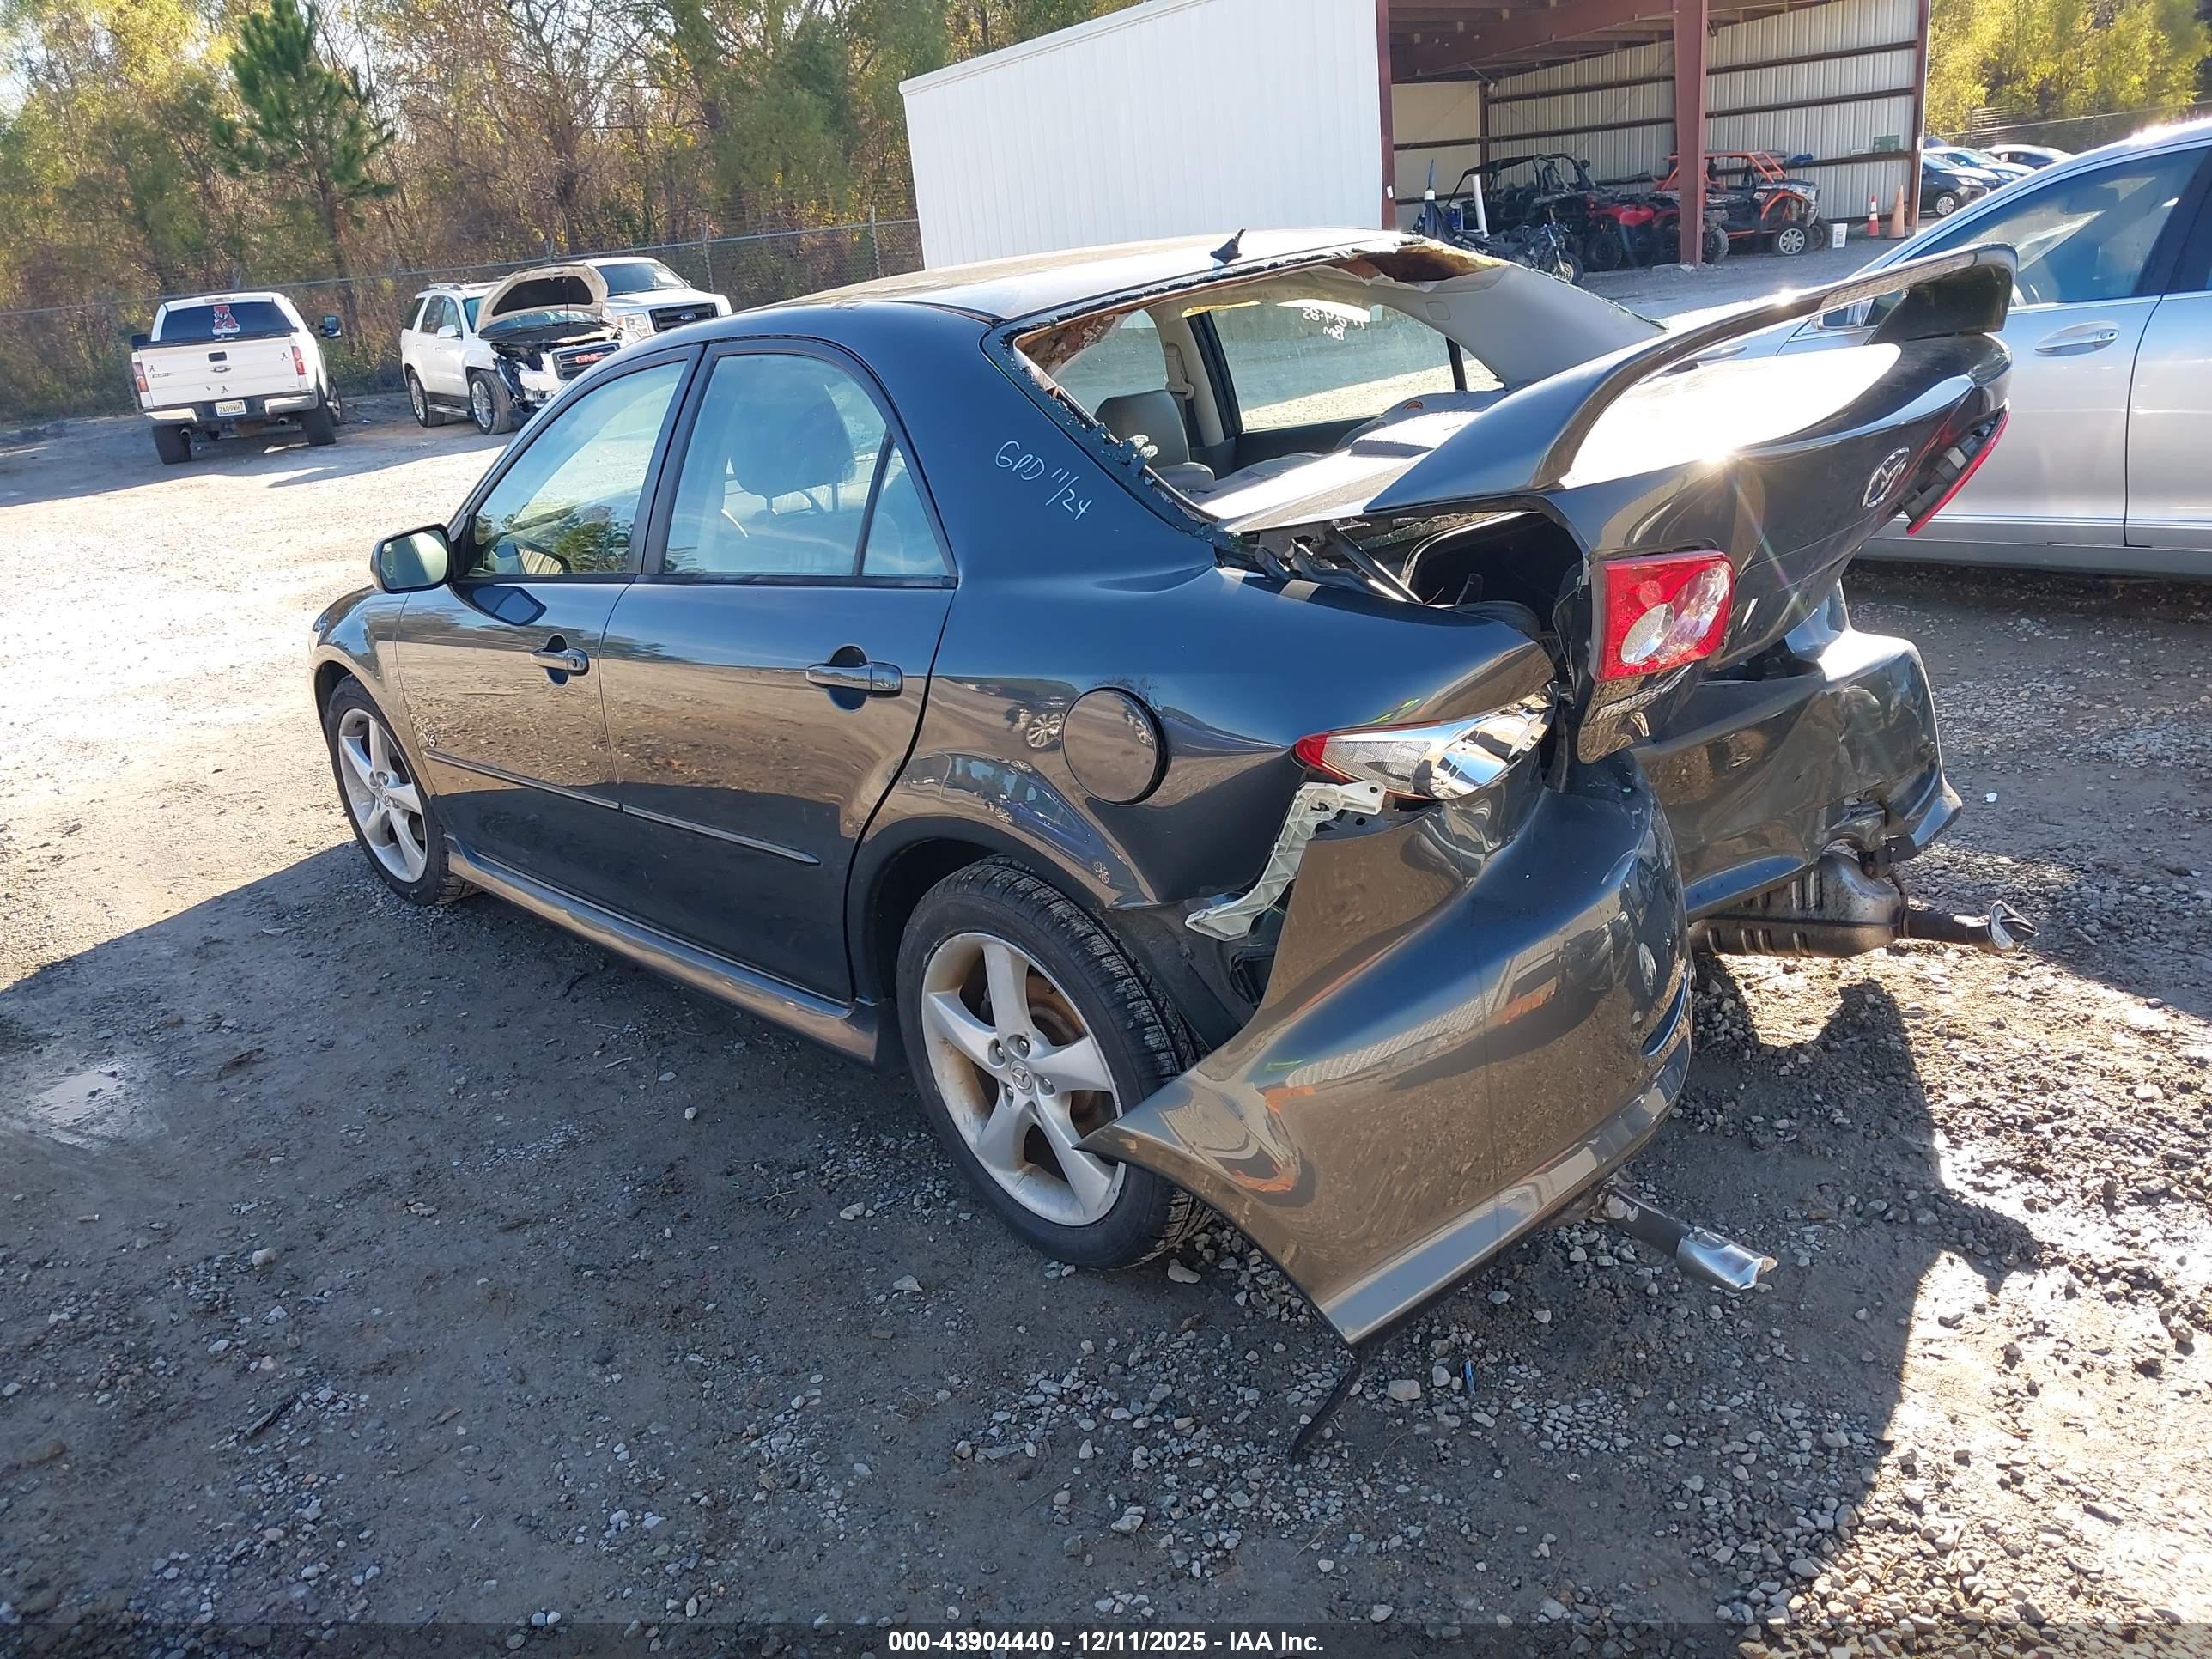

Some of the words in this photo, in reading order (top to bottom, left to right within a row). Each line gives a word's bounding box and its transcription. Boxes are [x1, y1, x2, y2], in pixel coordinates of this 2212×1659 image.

[575, 352, 605, 363] GMC
[1045, 468, 1093, 520] 11/24
[422, 733, 436, 748] V6
